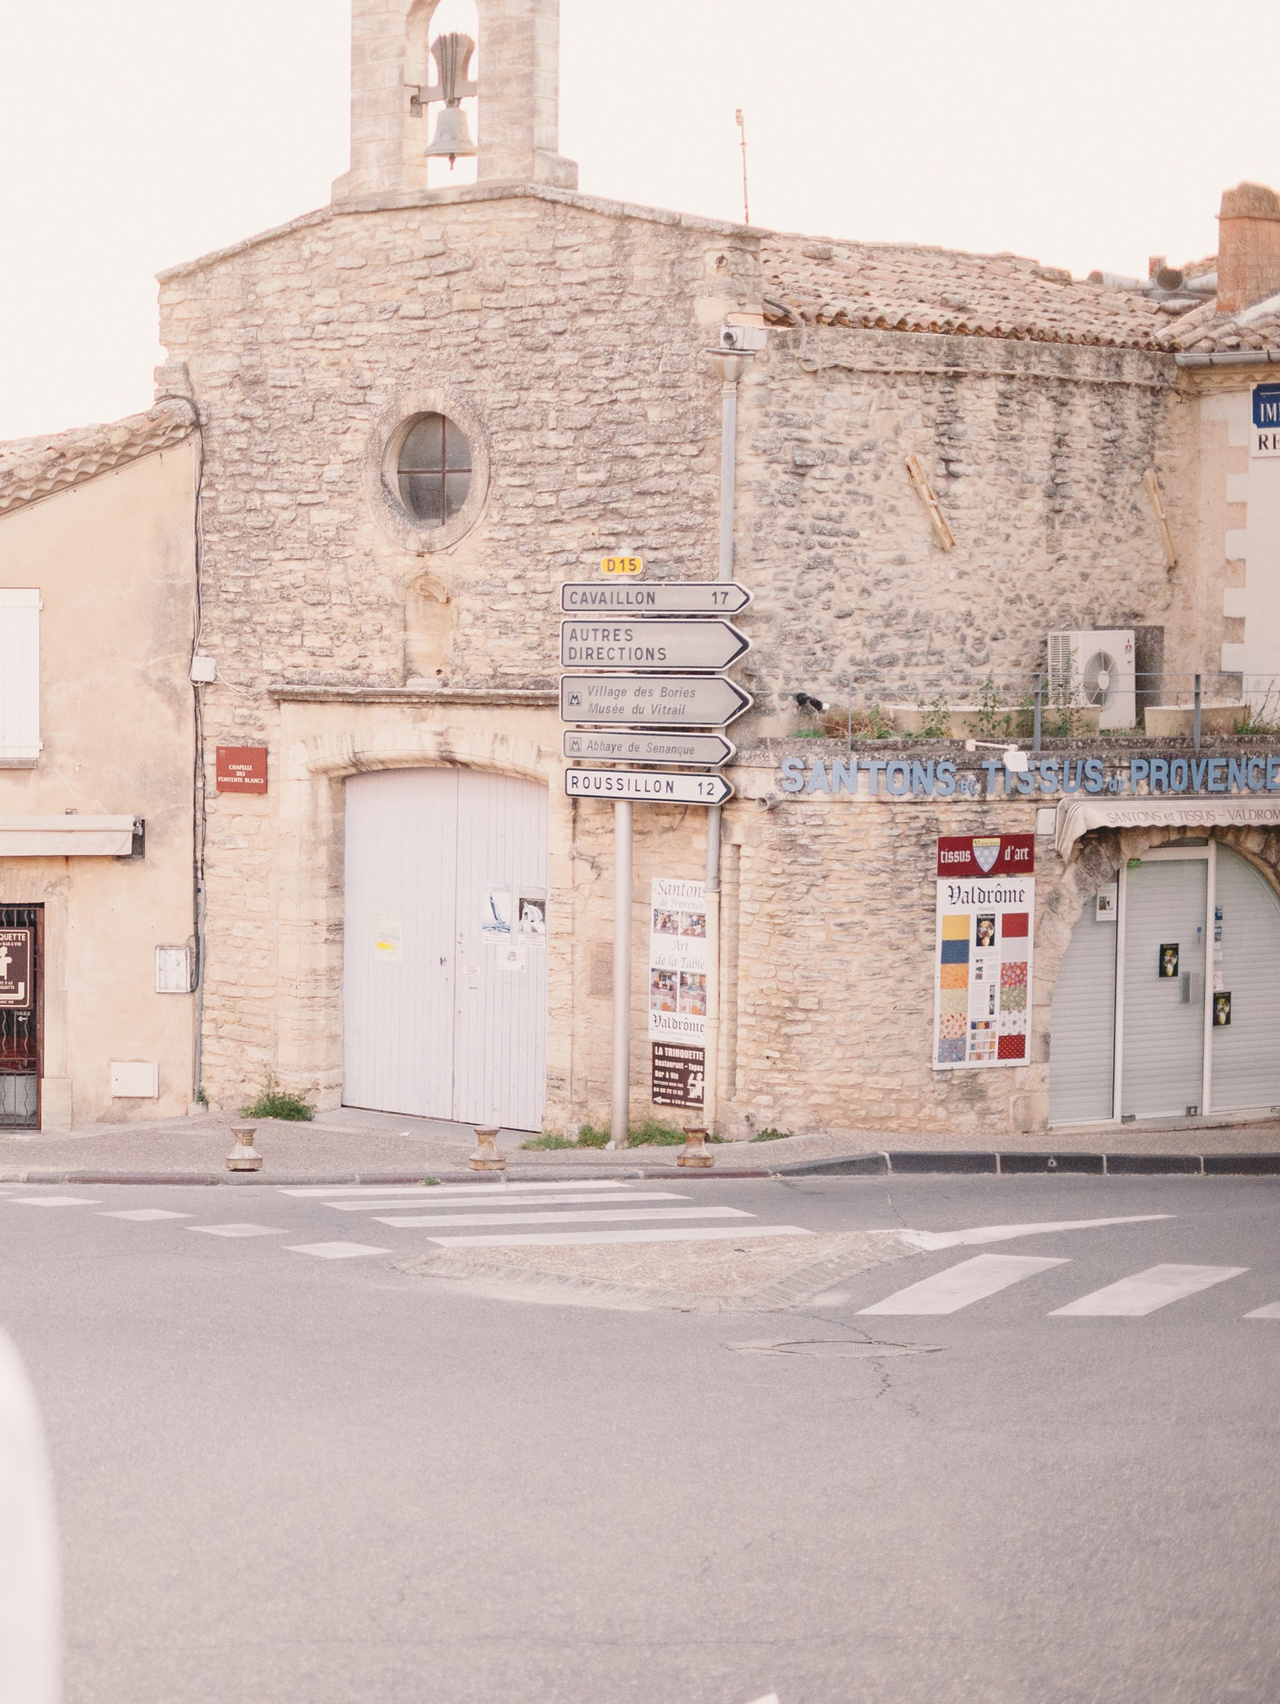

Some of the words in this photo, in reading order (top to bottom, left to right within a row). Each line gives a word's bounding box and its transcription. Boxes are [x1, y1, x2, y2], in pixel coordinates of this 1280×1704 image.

[1260, 402, 1280, 422] IM
[606, 558, 638, 573] D15
[569, 591, 656, 605] CAVAILLON
[711, 591, 729, 605] 17
[569, 628, 634, 642] AUTRES
[568, 646, 667, 661] DIRECTIONS
[587, 685, 627, 700] Village
[634, 686, 654, 698] des
[660, 687, 696, 699] Bories
[588, 703, 625, 715] Musée
[631, 704, 645, 715] du
[651, 704, 686, 716] Vitrail
[586, 739, 623, 753] Abbaye
[628, 741, 640, 752] de
[646, 742, 695, 756] Senanque
[781, 757, 957, 796] SANTONS
[959, 774, 976, 795] et
[982, 757, 1104, 794] TISSUS
[1108, 774, 1126, 793] de
[1130, 756, 1280, 793] PROVENCE
[571, 775, 675, 795] ROUSSILLON
[697, 782, 715, 796] 12
[1106, 810, 1162, 824] SANTONS
[1164, 811, 1175, 822] et
[1177, 809, 1216, 822] TISSUS
[940, 848, 971, 864] tissus
[1004, 845, 1030, 861] d'art
[657, 879, 705, 899] Santons
[947, 882, 1026, 906] Valdrôme
[671, 939, 689, 952] Art
[654, 953, 665, 966] de
[668, 954, 677, 968] la
[681, 957, 705, 970] Table
[652, 1013, 705, 1034] Valdrôme
[654, 1046, 663, 1056] LA
[664, 1047, 704, 1061] TRINQUETTE
